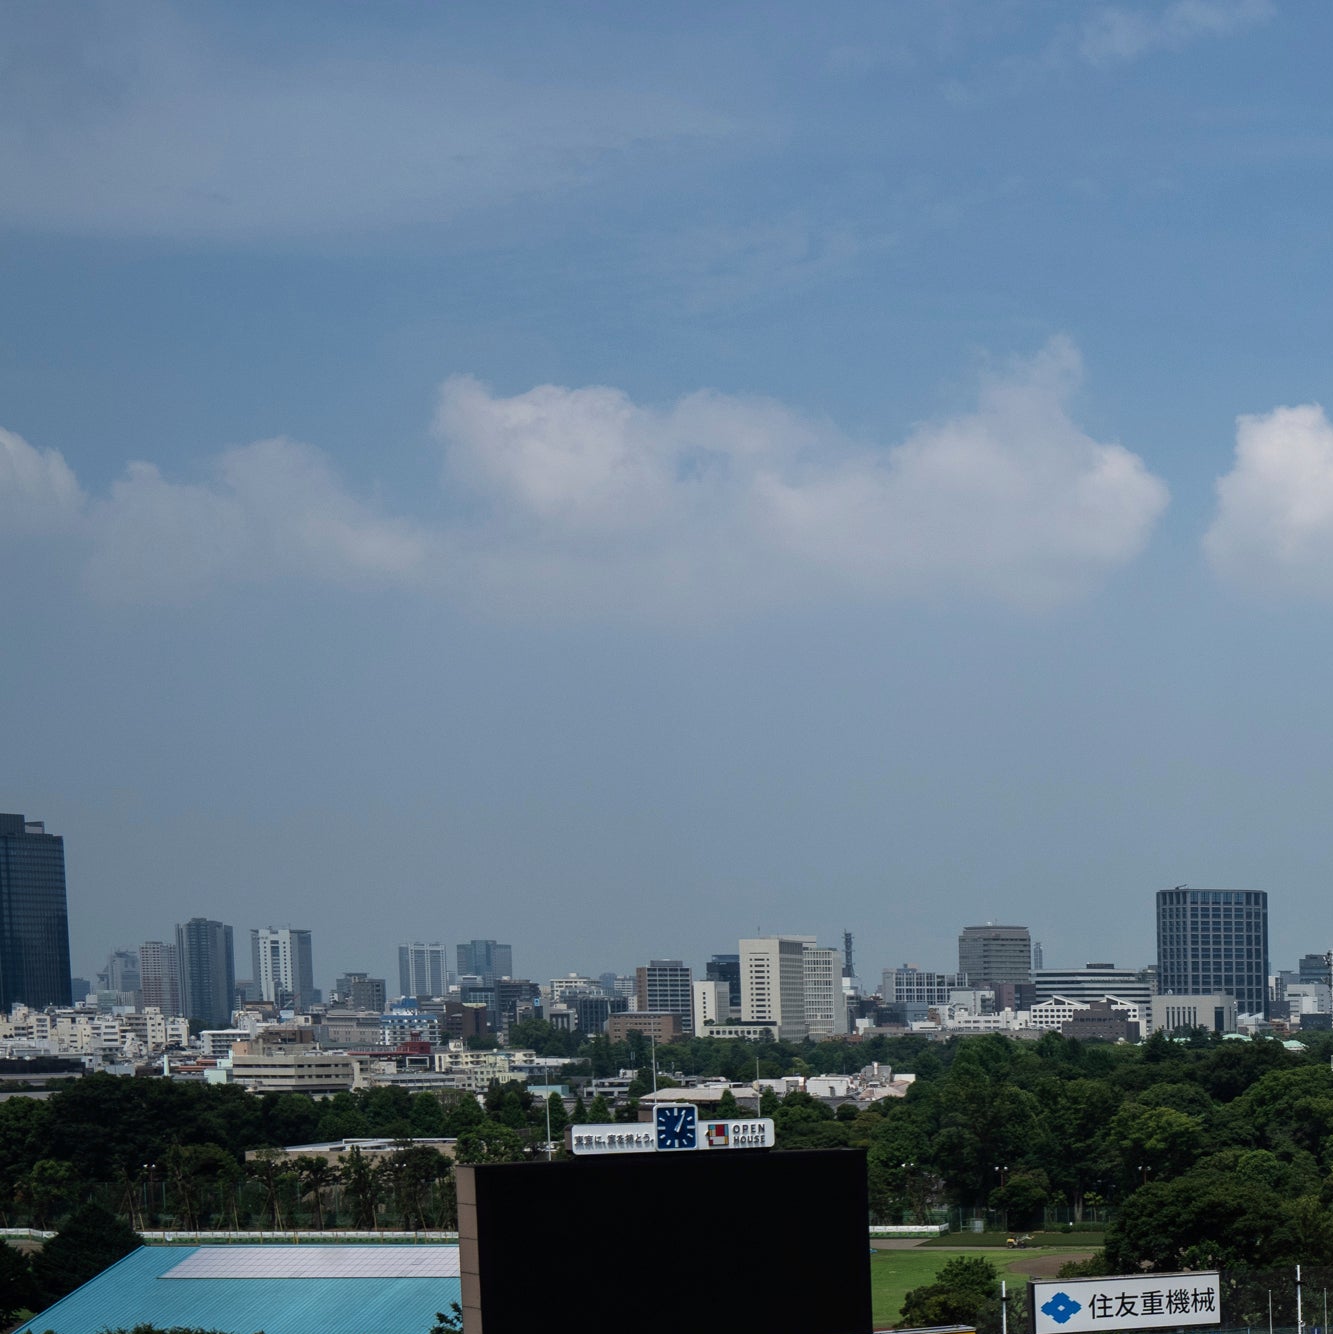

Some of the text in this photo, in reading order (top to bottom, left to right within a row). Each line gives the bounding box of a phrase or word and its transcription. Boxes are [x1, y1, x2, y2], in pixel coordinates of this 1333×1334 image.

[733, 1123, 766, 1134] OPEN
[733, 1134, 766, 1144] HOUSE
[1089, 1287, 1216, 1320] 住友重機械
